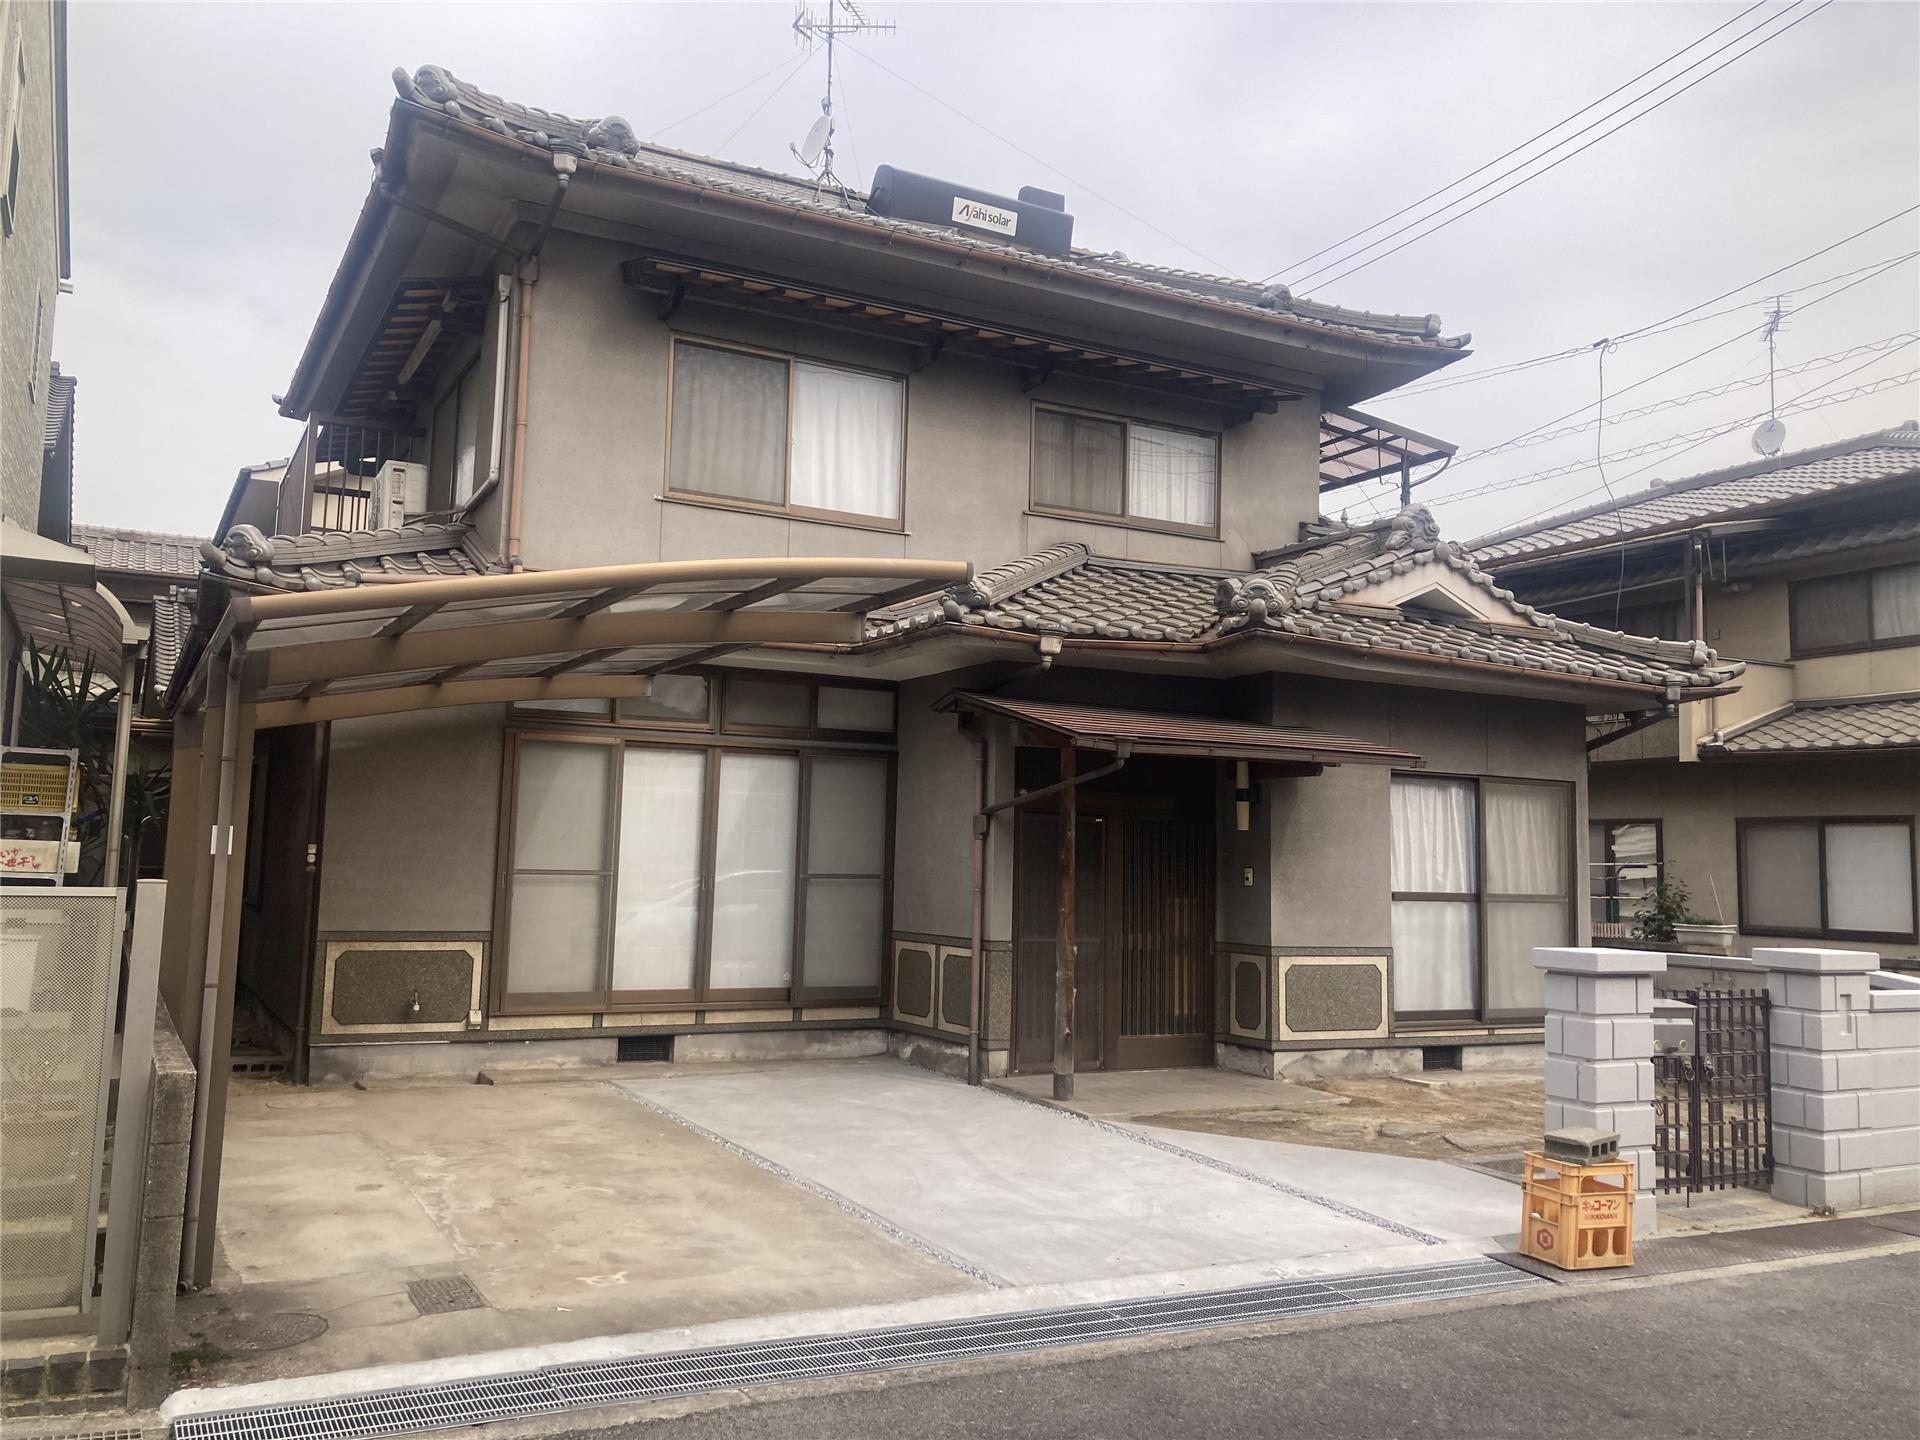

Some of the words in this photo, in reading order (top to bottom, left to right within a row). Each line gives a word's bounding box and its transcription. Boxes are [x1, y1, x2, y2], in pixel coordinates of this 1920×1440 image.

[988, 213, 1011, 226] solar
[1581, 1199, 1621, 1212] キッコーマン
